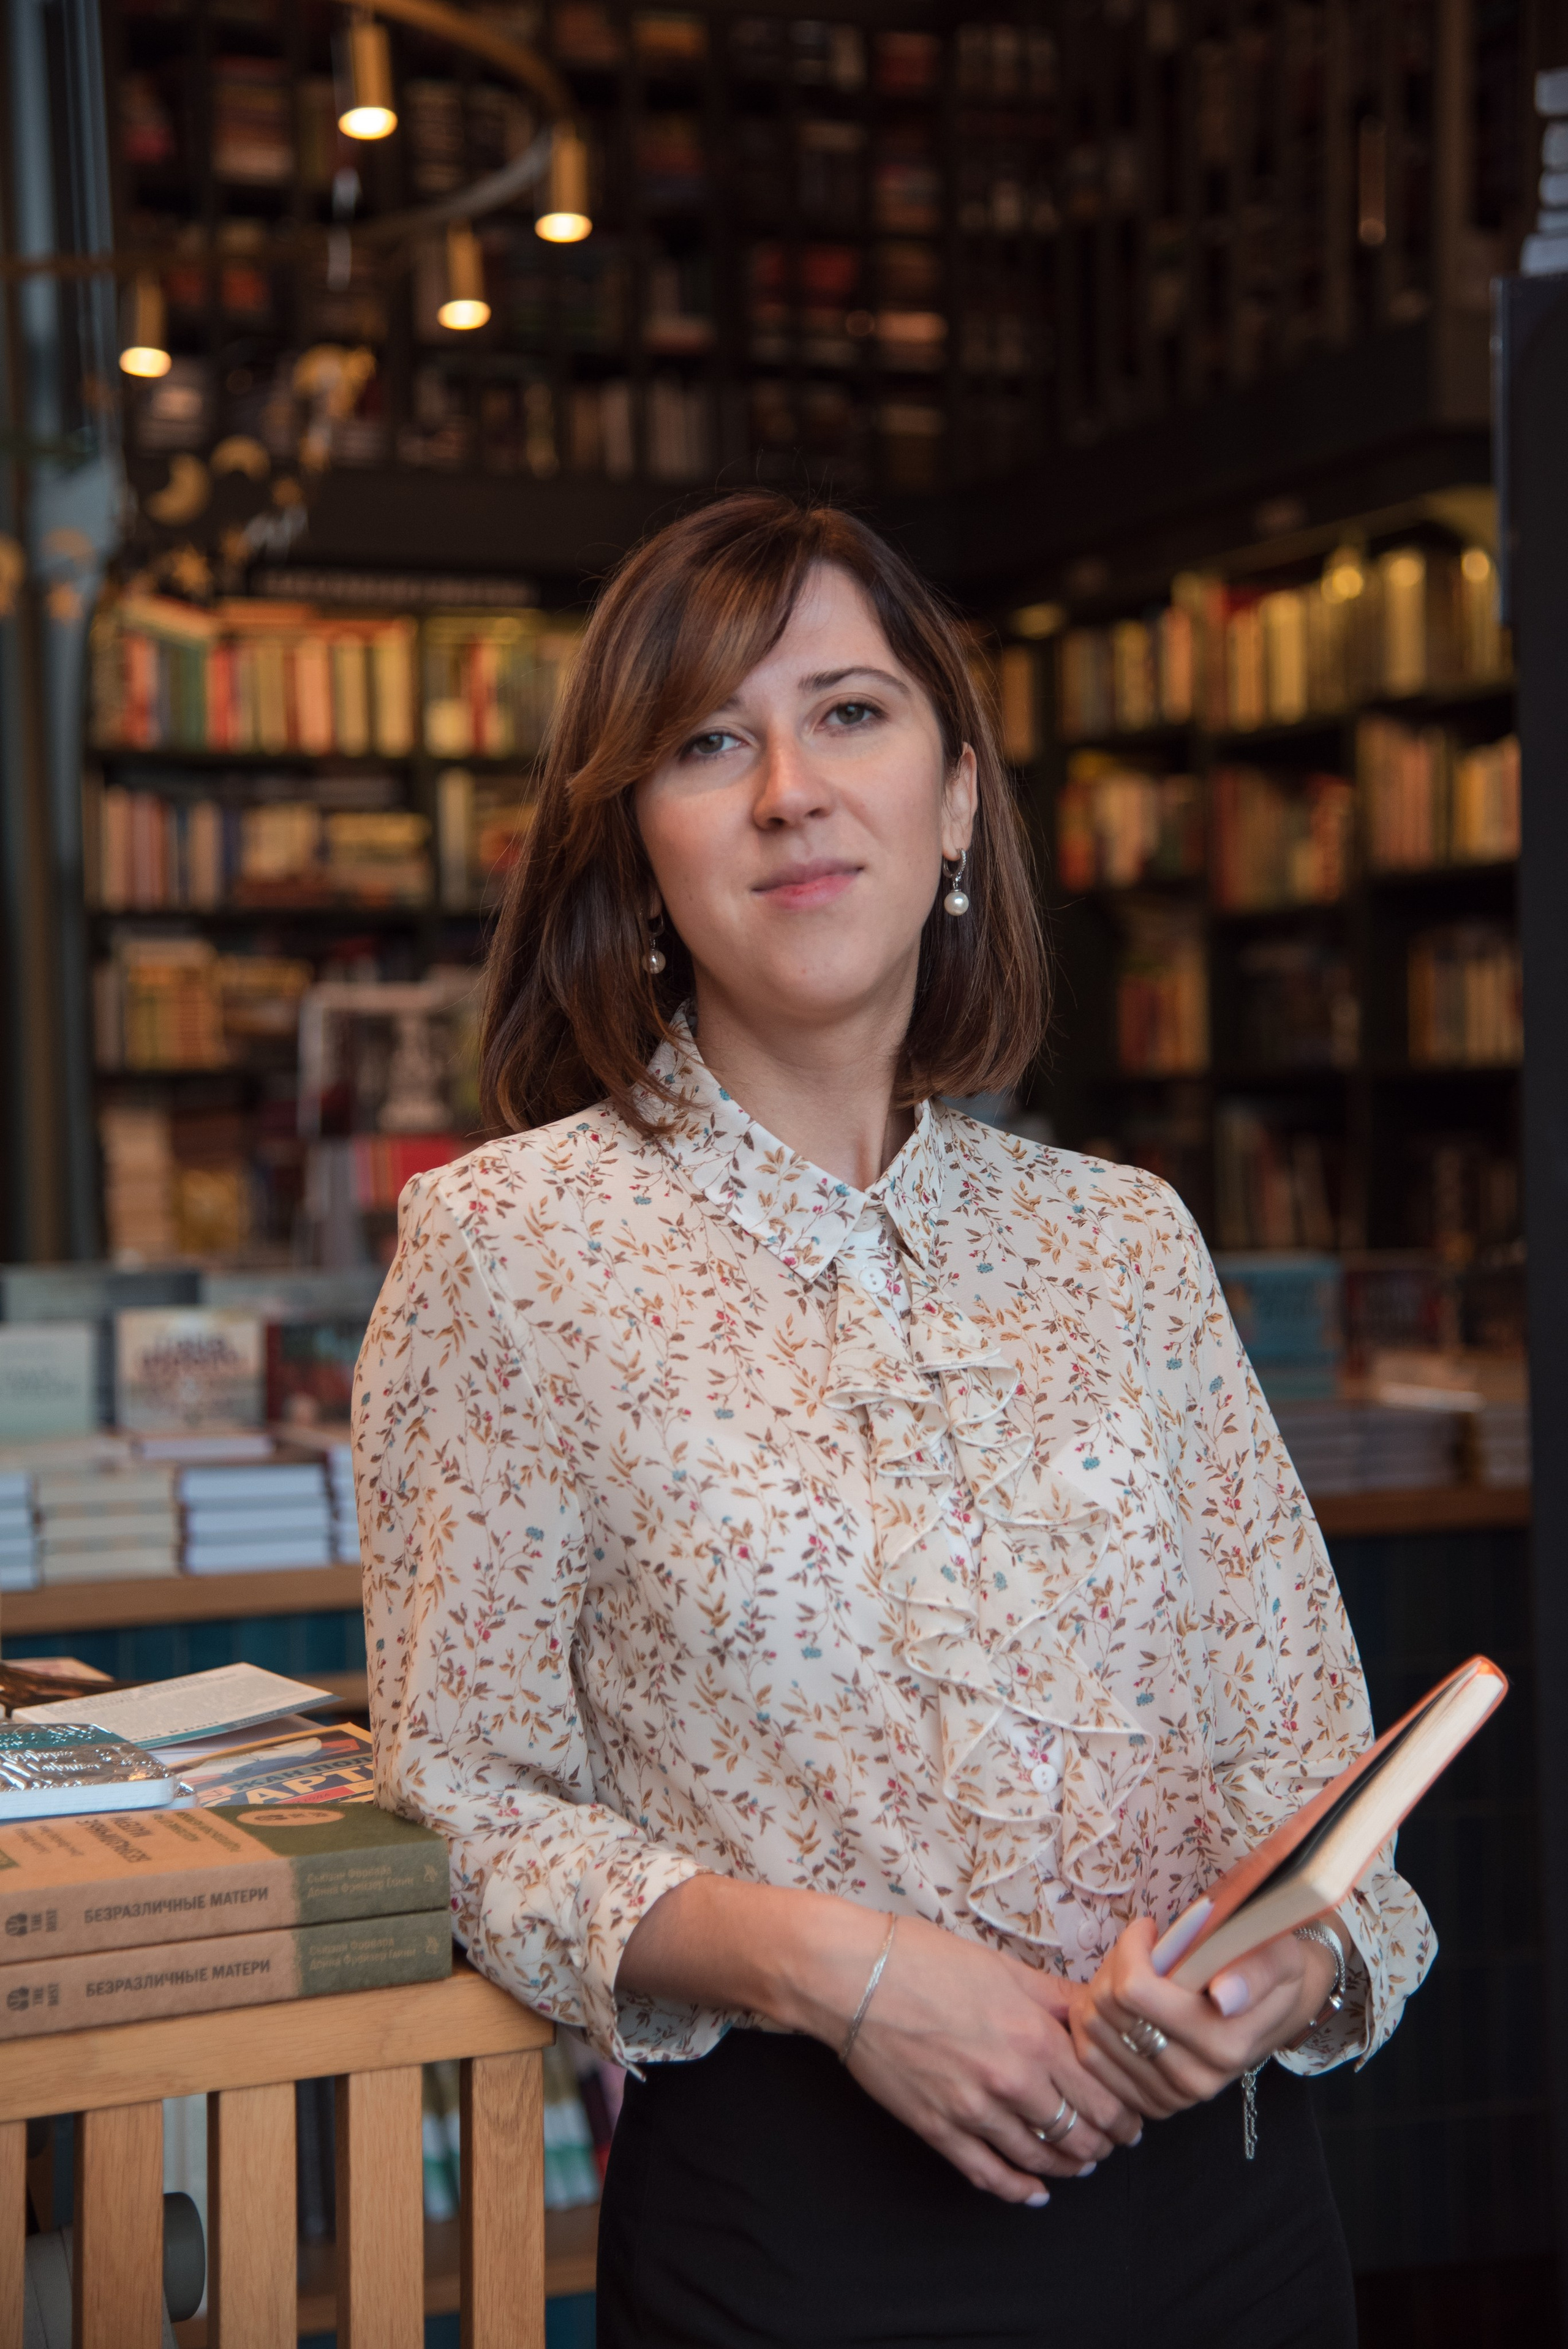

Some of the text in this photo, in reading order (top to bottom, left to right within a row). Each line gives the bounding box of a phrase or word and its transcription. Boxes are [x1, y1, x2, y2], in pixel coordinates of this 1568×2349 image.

[201, 1764, 374, 1808] САРТ
[231, 1756, 373, 1790] ЖАН ПОЛ
[83, 1886, 268, 1924] БЕЗРАЗЛИЧНЫЕ МАТЕРИ
[85, 1959, 271, 1997] БЕЗРАЗЛИЧНЫЕ МАТЕРИ
